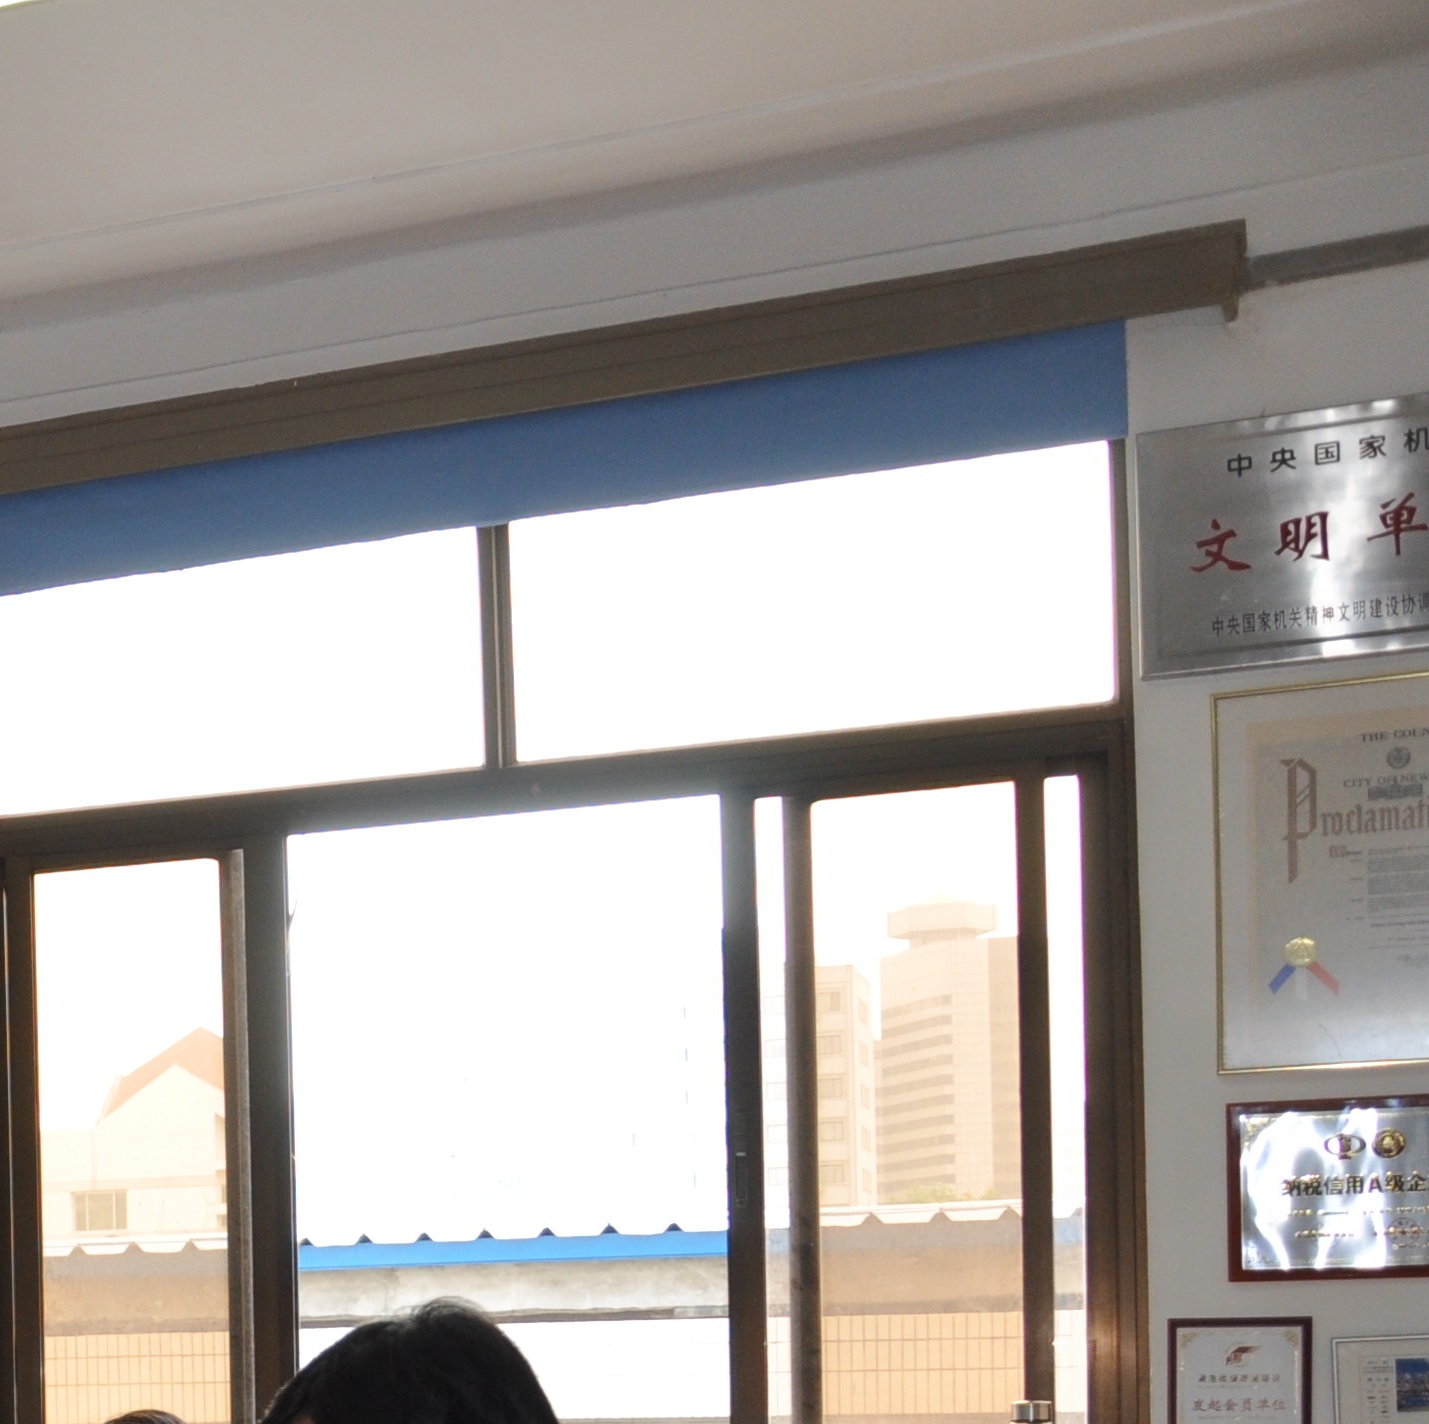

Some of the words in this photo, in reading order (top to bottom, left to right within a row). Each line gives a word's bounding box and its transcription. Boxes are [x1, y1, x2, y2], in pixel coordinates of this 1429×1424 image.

[1191, 491, 1429, 573] 文明单
[1361, 731, 1389, 743] THE
[1343, 777, 1372, 788] CITY
[1282, 1171, 1429, 1196] 纳税信用A级企
